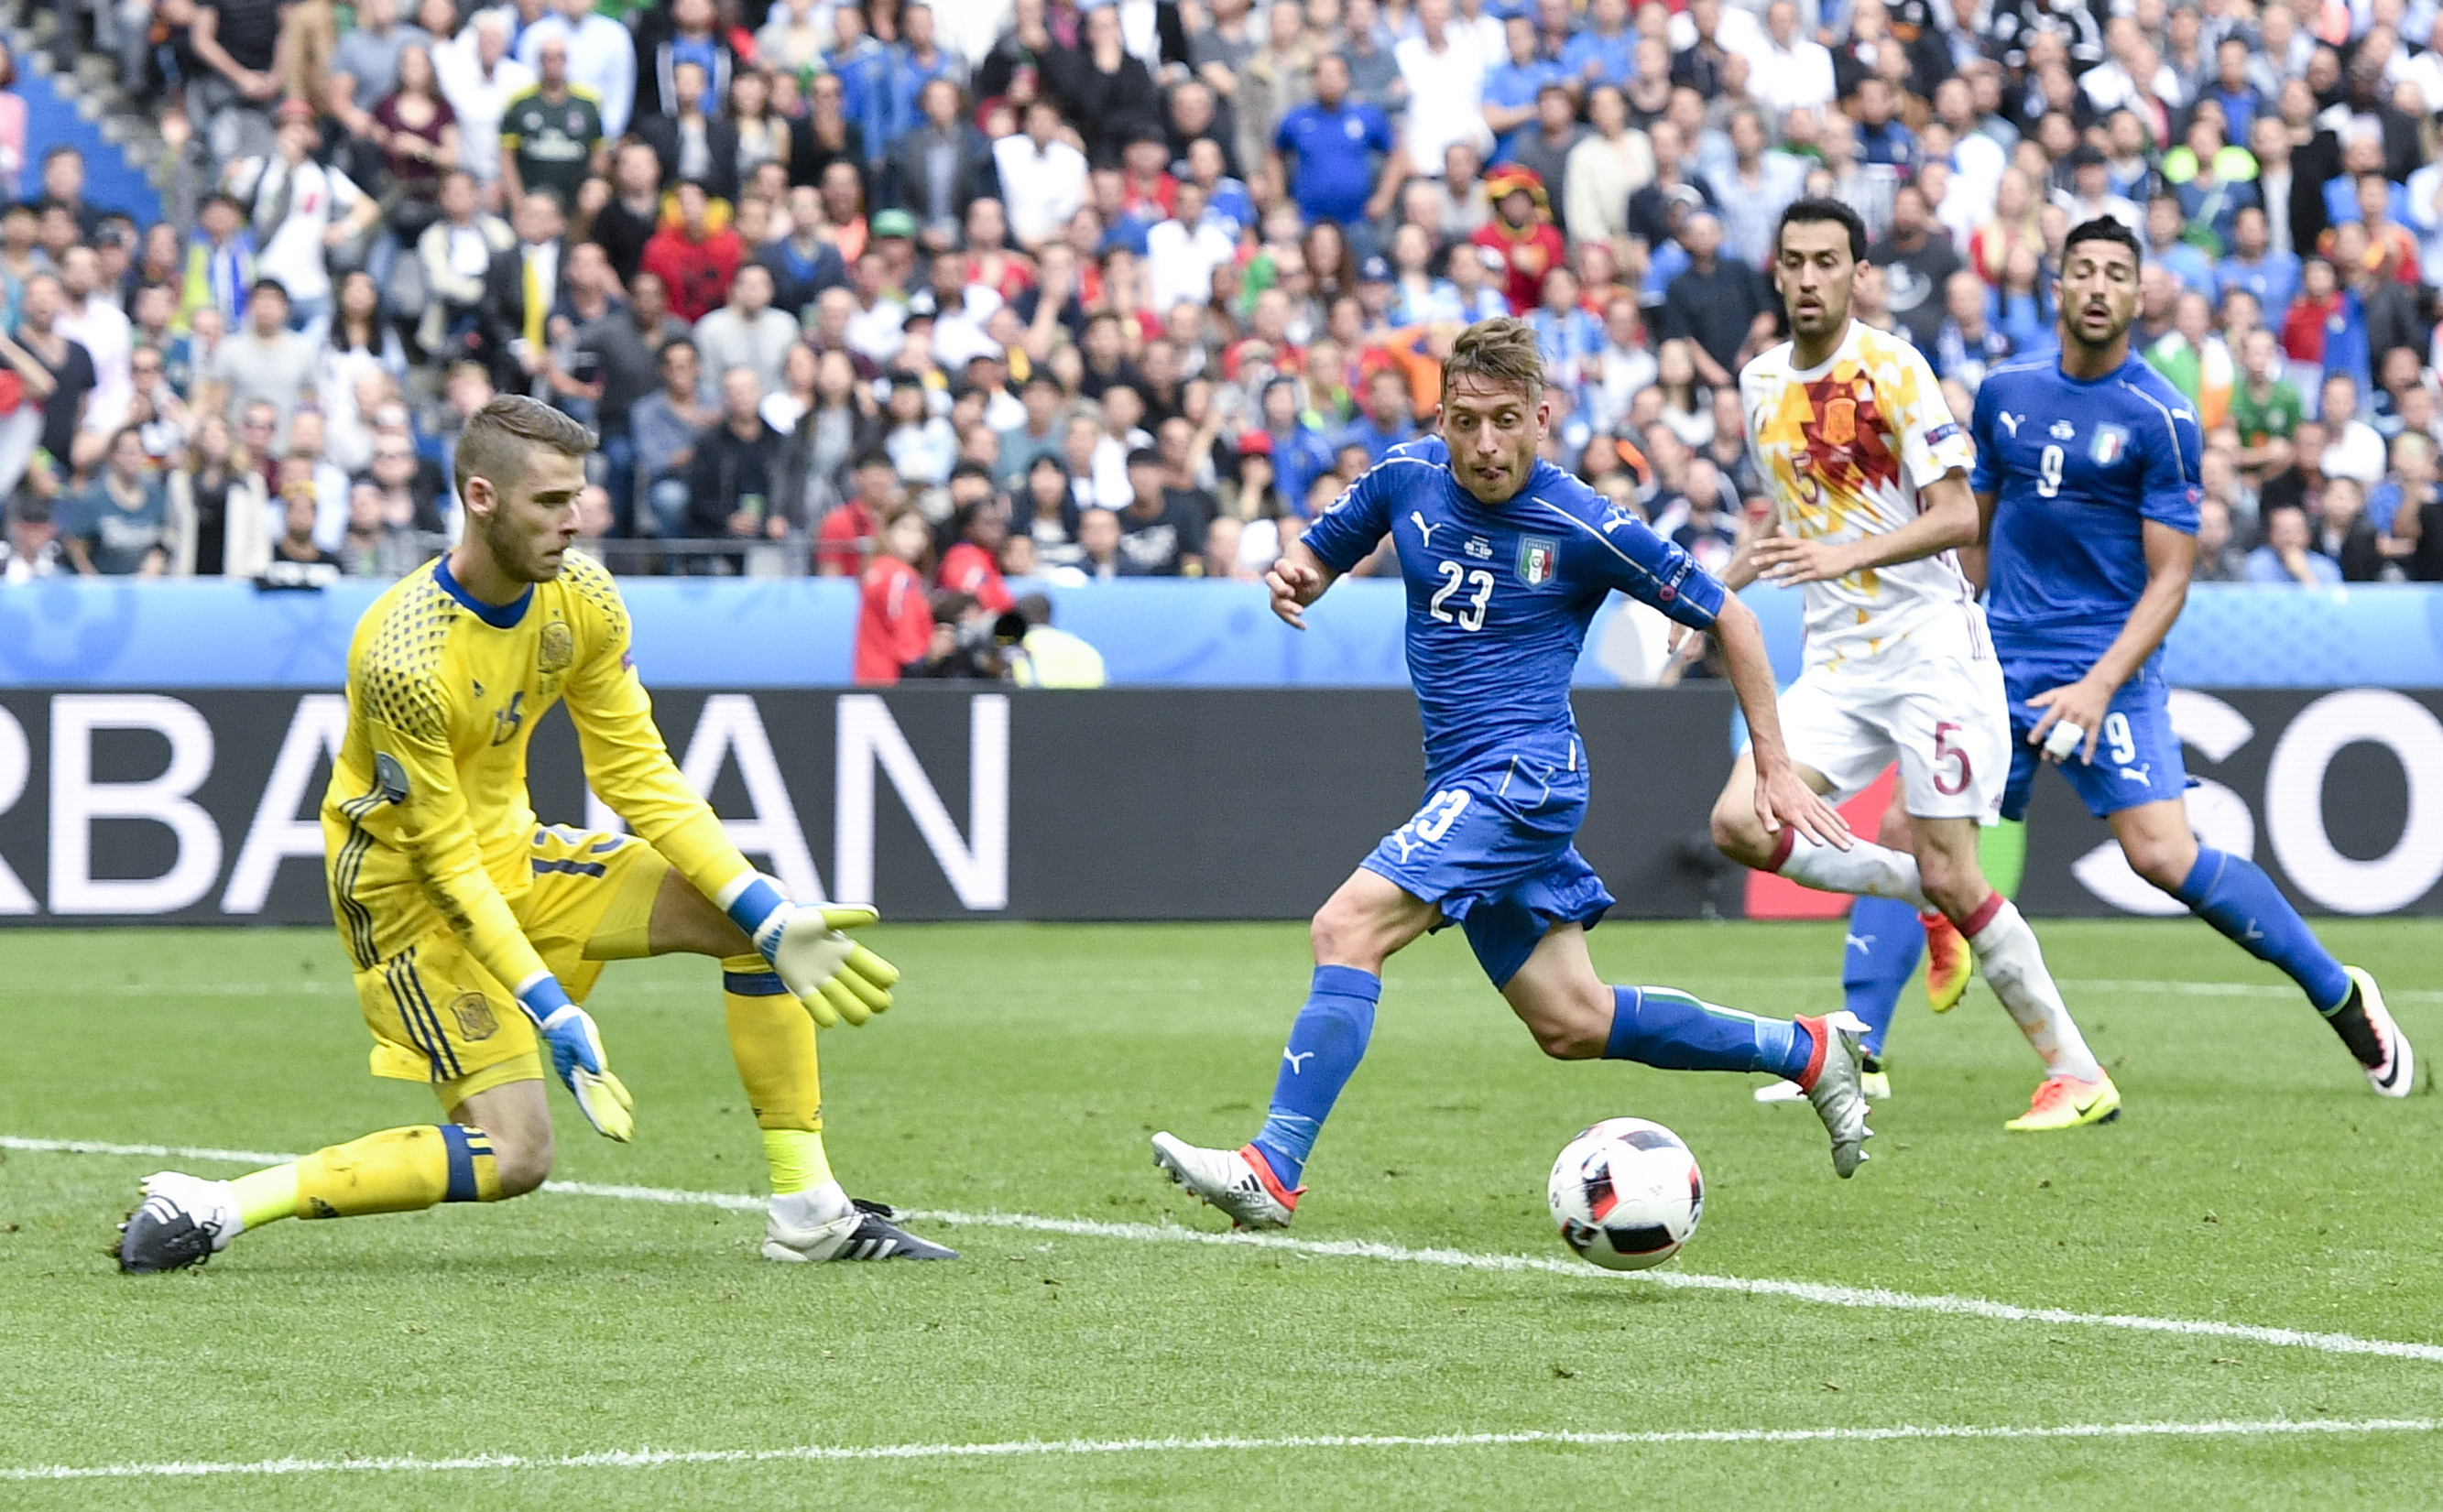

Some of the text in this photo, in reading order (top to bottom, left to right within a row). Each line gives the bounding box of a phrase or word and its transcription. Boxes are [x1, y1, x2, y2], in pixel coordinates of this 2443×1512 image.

[1791, 452, 1819, 505] 5
[2036, 444, 2064, 498] 9
[1430, 560, 1495, 632] 23
[1933, 721, 1972, 796] 5
[2106, 712, 2136, 765] 9
